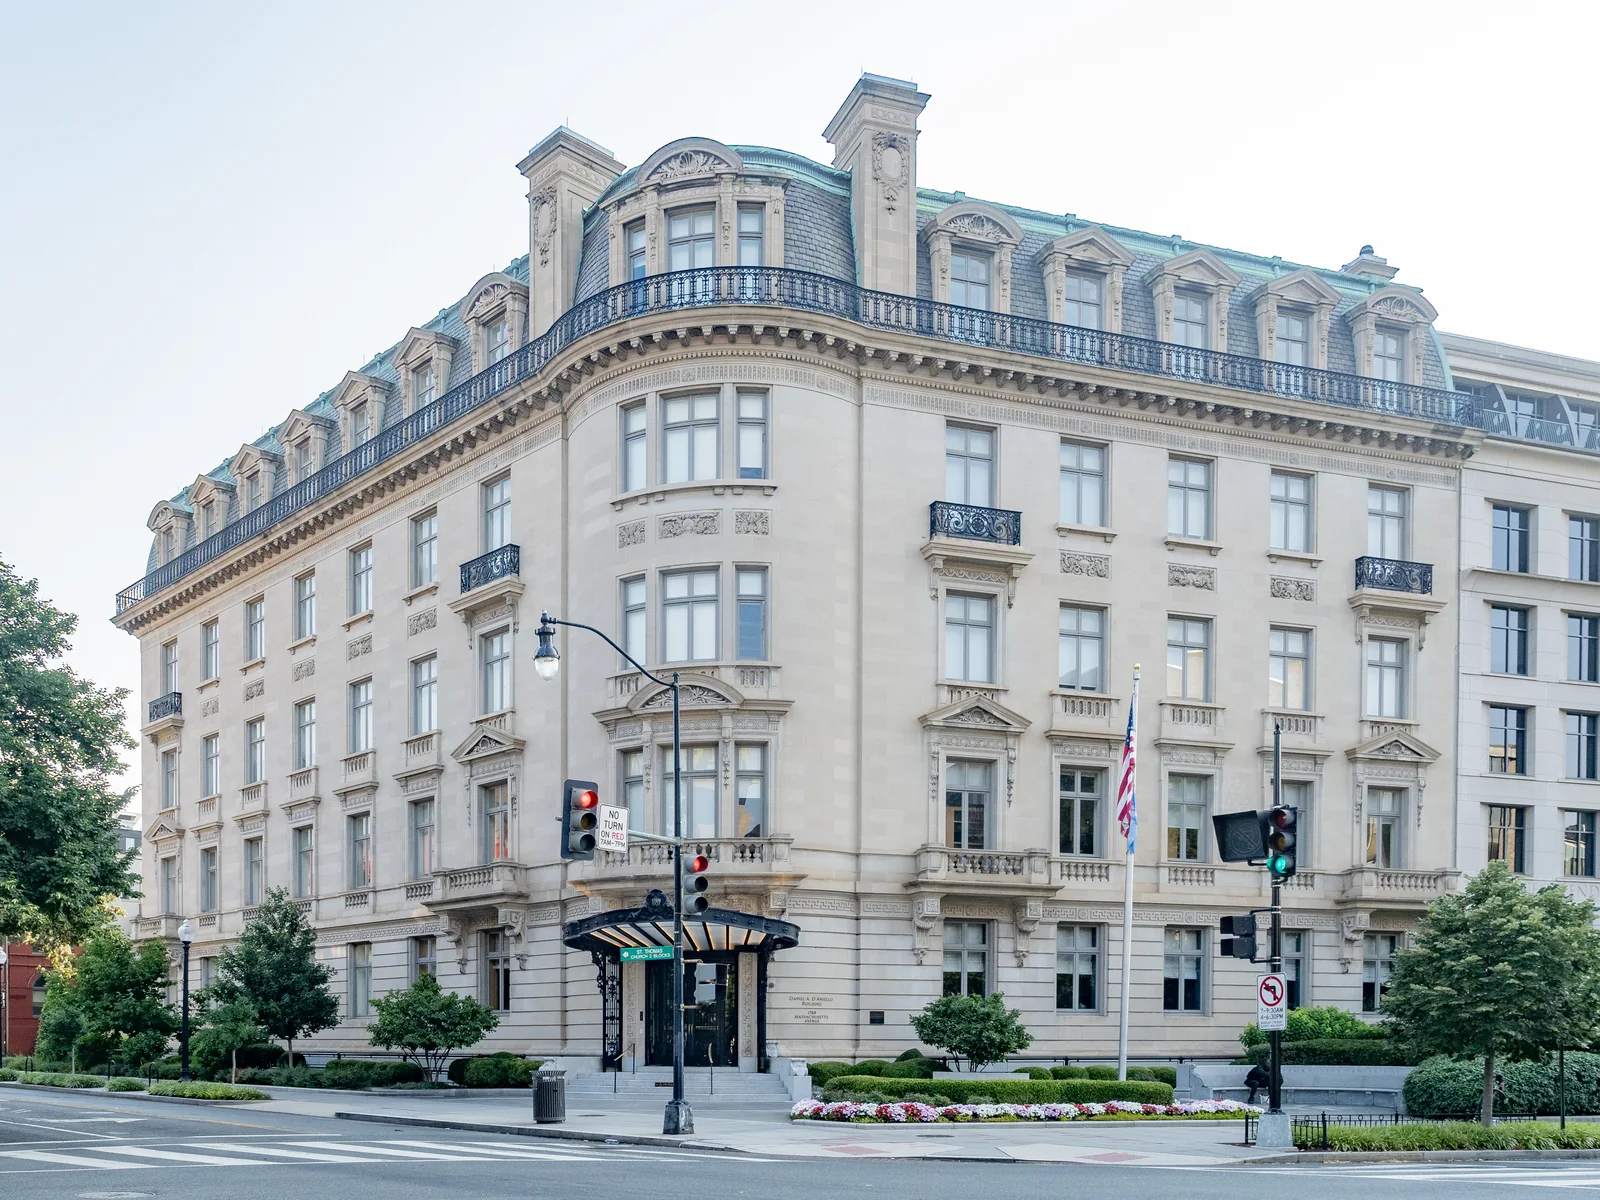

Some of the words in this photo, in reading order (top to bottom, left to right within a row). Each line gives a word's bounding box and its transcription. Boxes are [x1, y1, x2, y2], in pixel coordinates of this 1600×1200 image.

[609, 810, 619, 819] NO
[604, 820, 623, 830] TURN
[612, 832, 624, 840] RED
[601, 839, 625, 848] 7AM-7PM
